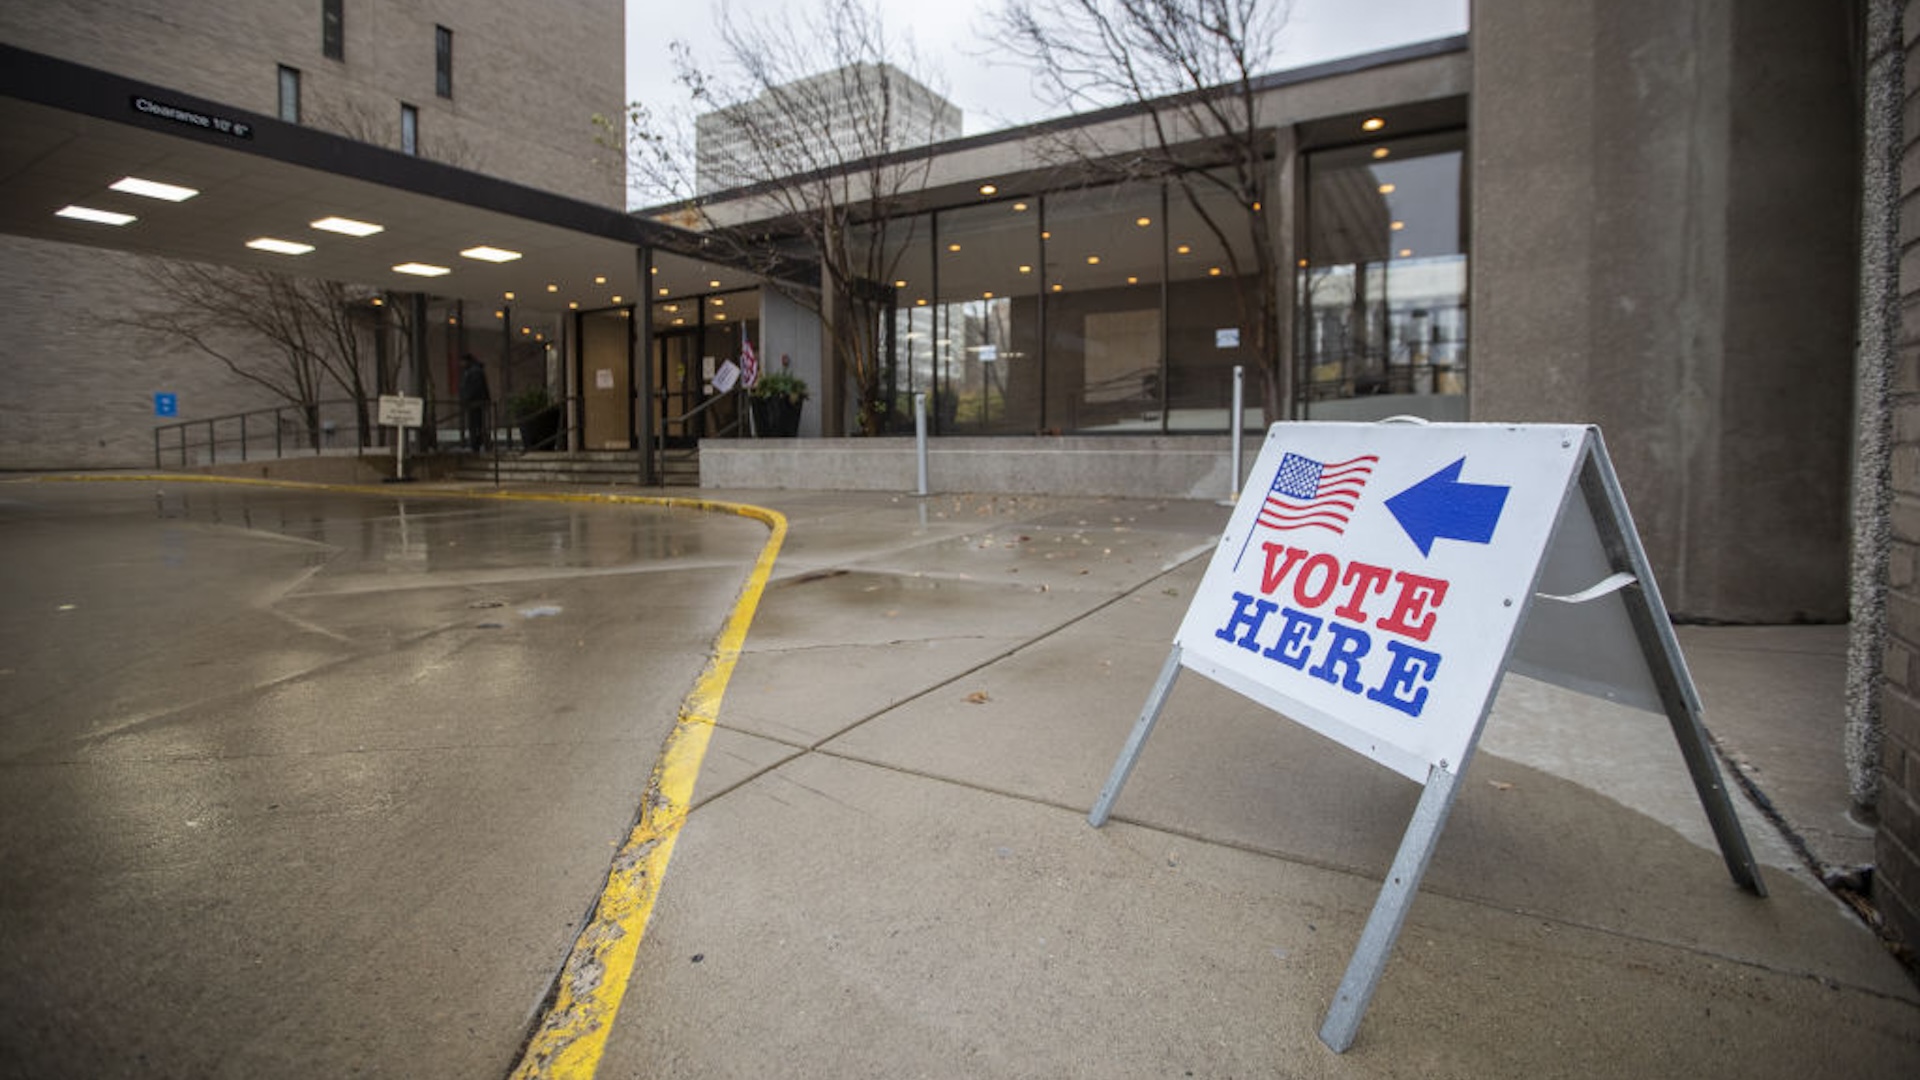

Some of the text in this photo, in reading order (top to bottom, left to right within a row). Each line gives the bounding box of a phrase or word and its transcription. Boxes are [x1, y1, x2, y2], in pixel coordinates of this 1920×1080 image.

[135, 98, 210, 127] Clearance
[1261, 541, 1449, 642] VOTE
[1215, 591, 1442, 718] HERE
